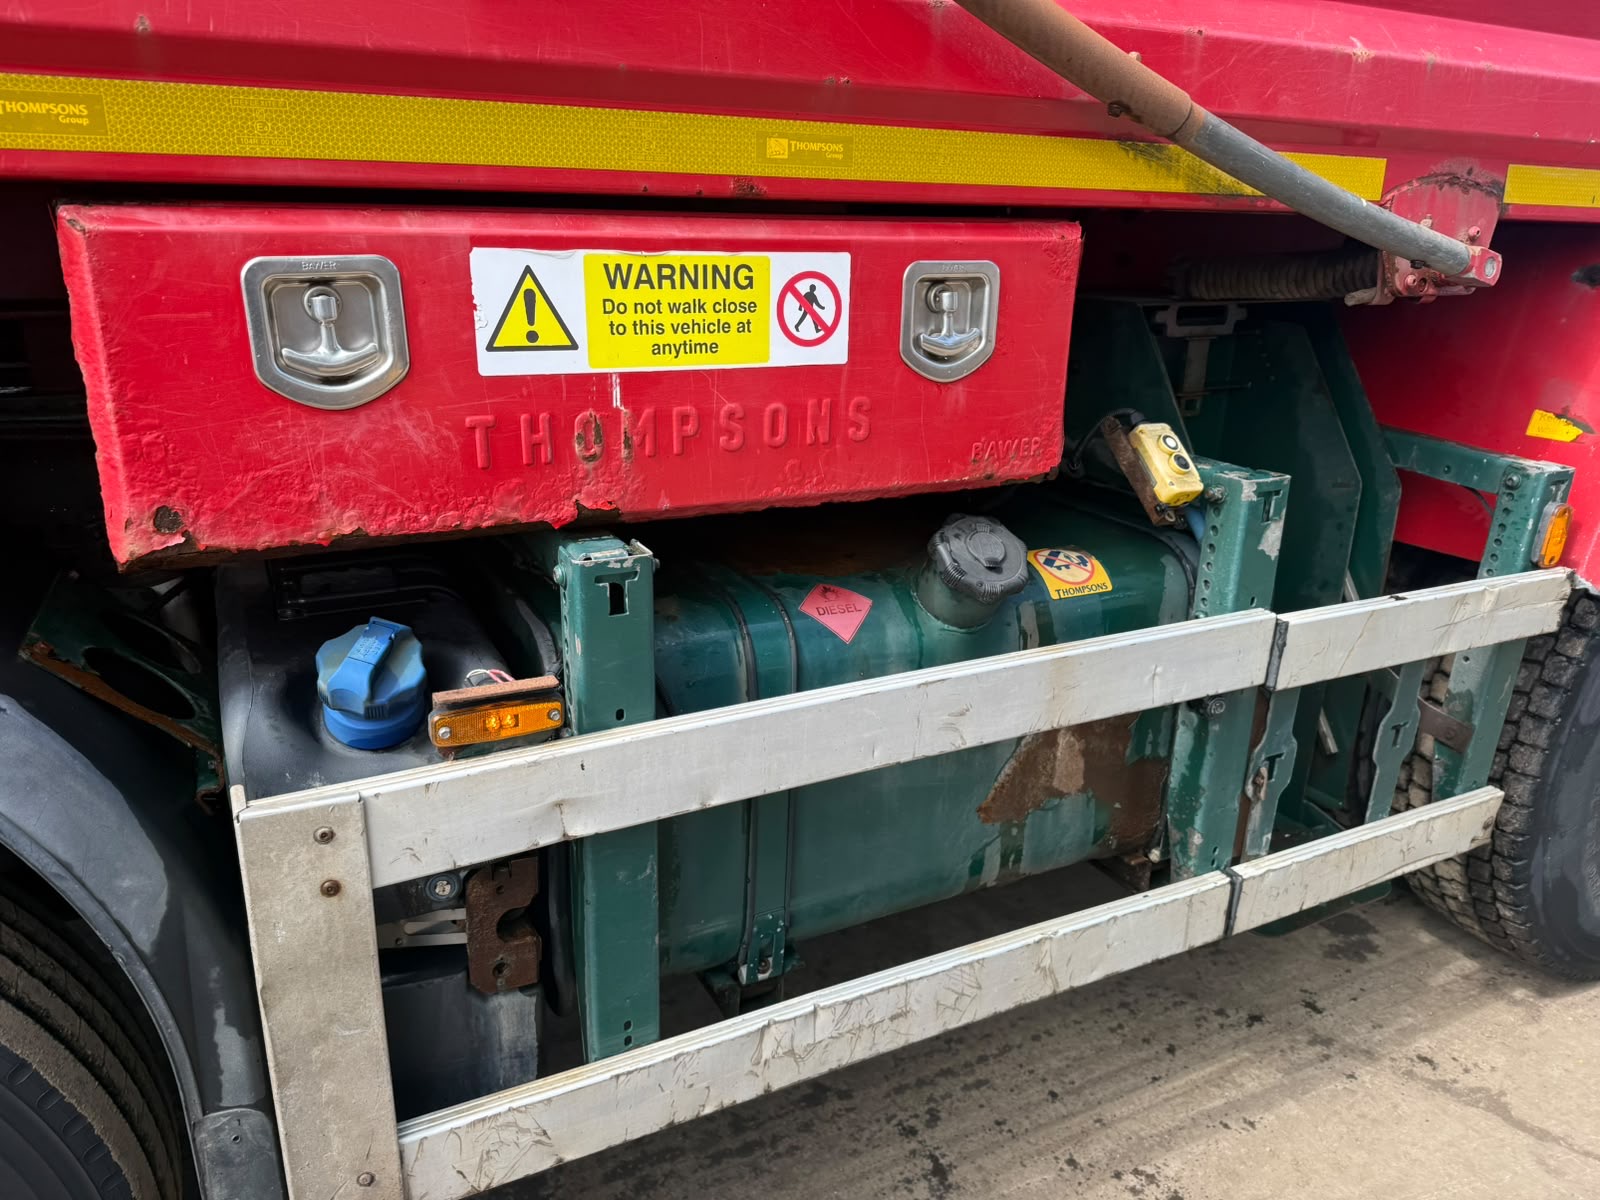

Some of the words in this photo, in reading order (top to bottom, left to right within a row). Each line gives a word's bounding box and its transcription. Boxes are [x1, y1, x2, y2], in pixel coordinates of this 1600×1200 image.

[58, 115, 89, 126] Group
[790, 140, 844, 152] THOMPSONS
[825, 152, 844, 161] Group
[603, 263, 754, 290] WARNING
[602, 298, 628, 314] Do
[634, 299, 663, 315] not
[667, 298, 707, 314] walk
[712, 298, 758, 314] close
[609, 320, 627, 336] to
[632, 319, 666, 335] this
[671, 318, 731, 335] vehicle
[736, 319, 752, 334] at
[651, 339, 719, 358] anytime
[465, 396, 872, 469] THOMPSONS
[971, 437, 1043, 463] BAWER
[1055, 582, 1108, 599] THOMPSONS
[816, 603, 863, 616] DIESEL
